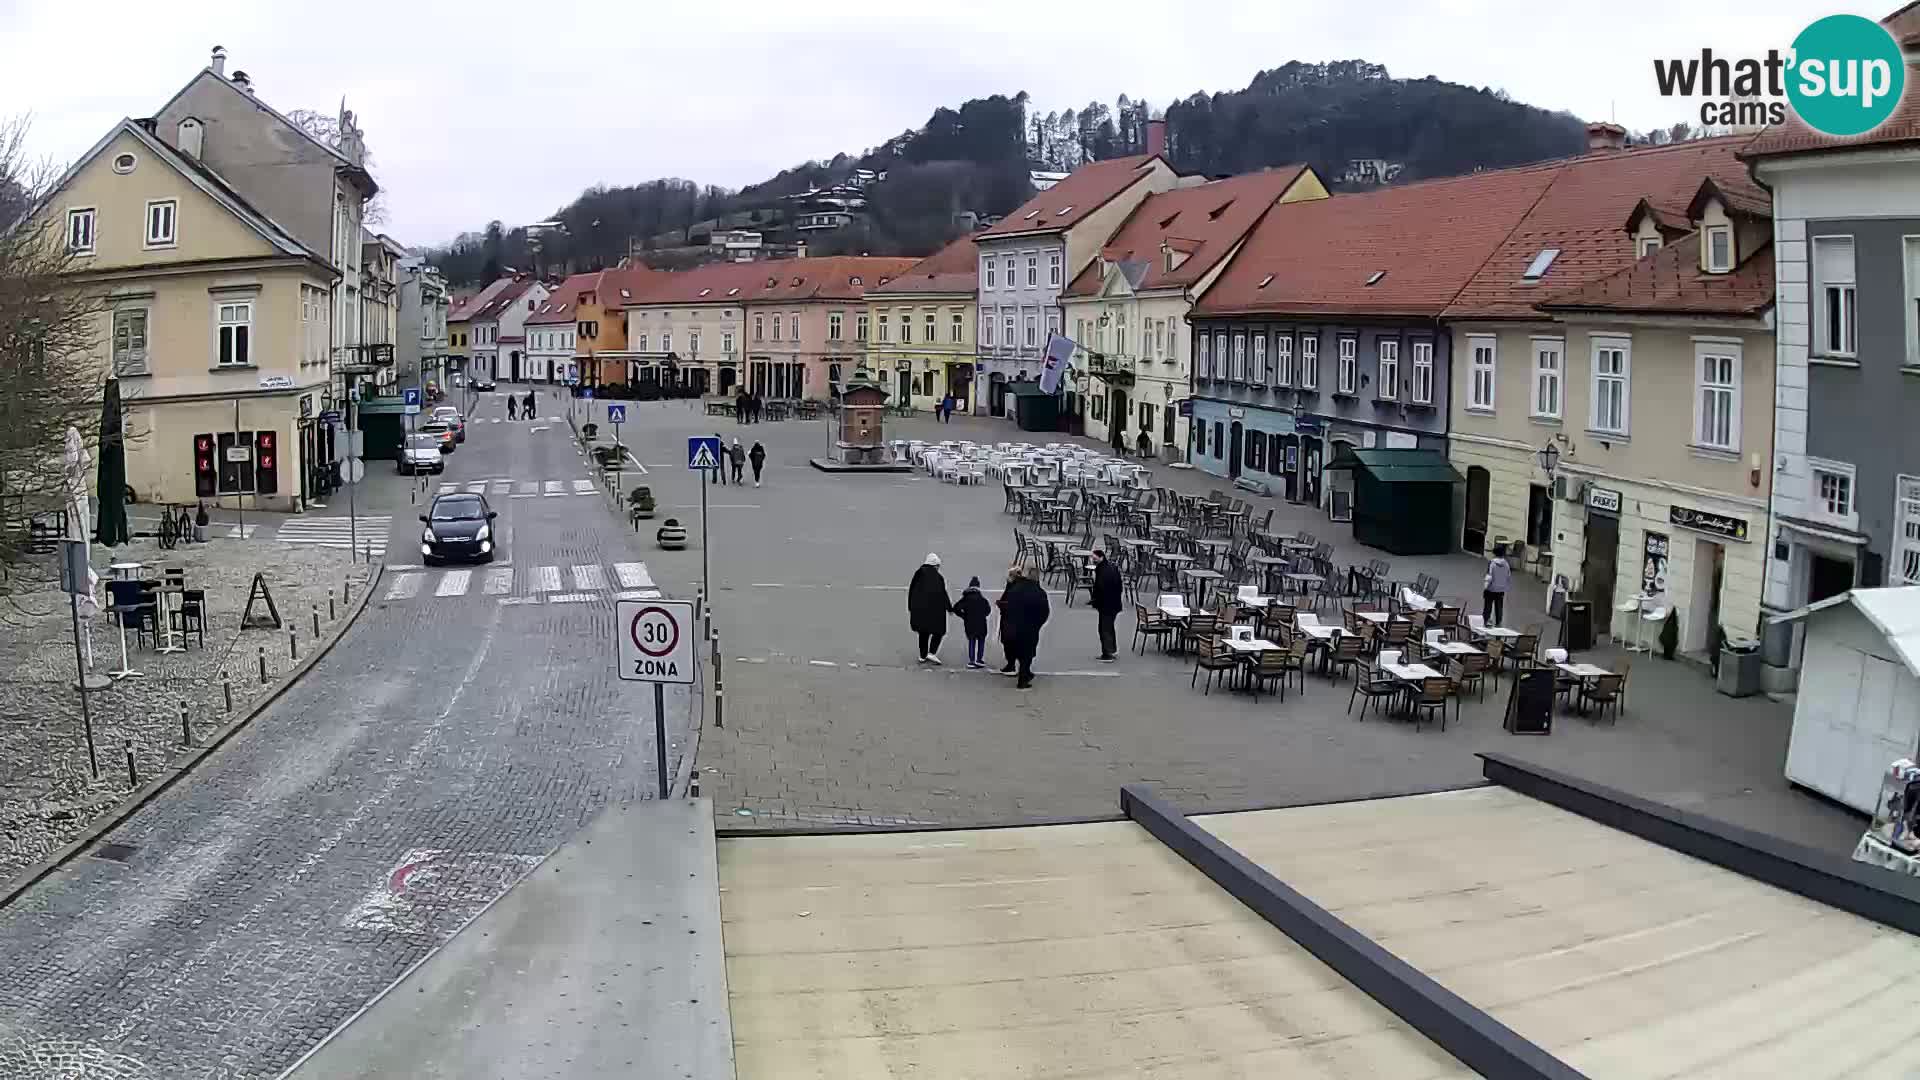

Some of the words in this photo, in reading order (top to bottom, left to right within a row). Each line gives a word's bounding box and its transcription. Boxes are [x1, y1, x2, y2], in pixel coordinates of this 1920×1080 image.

[408, 392, 416, 403] P
[643, 622, 668, 643] 30
[634, 659, 678, 677] ZONA
